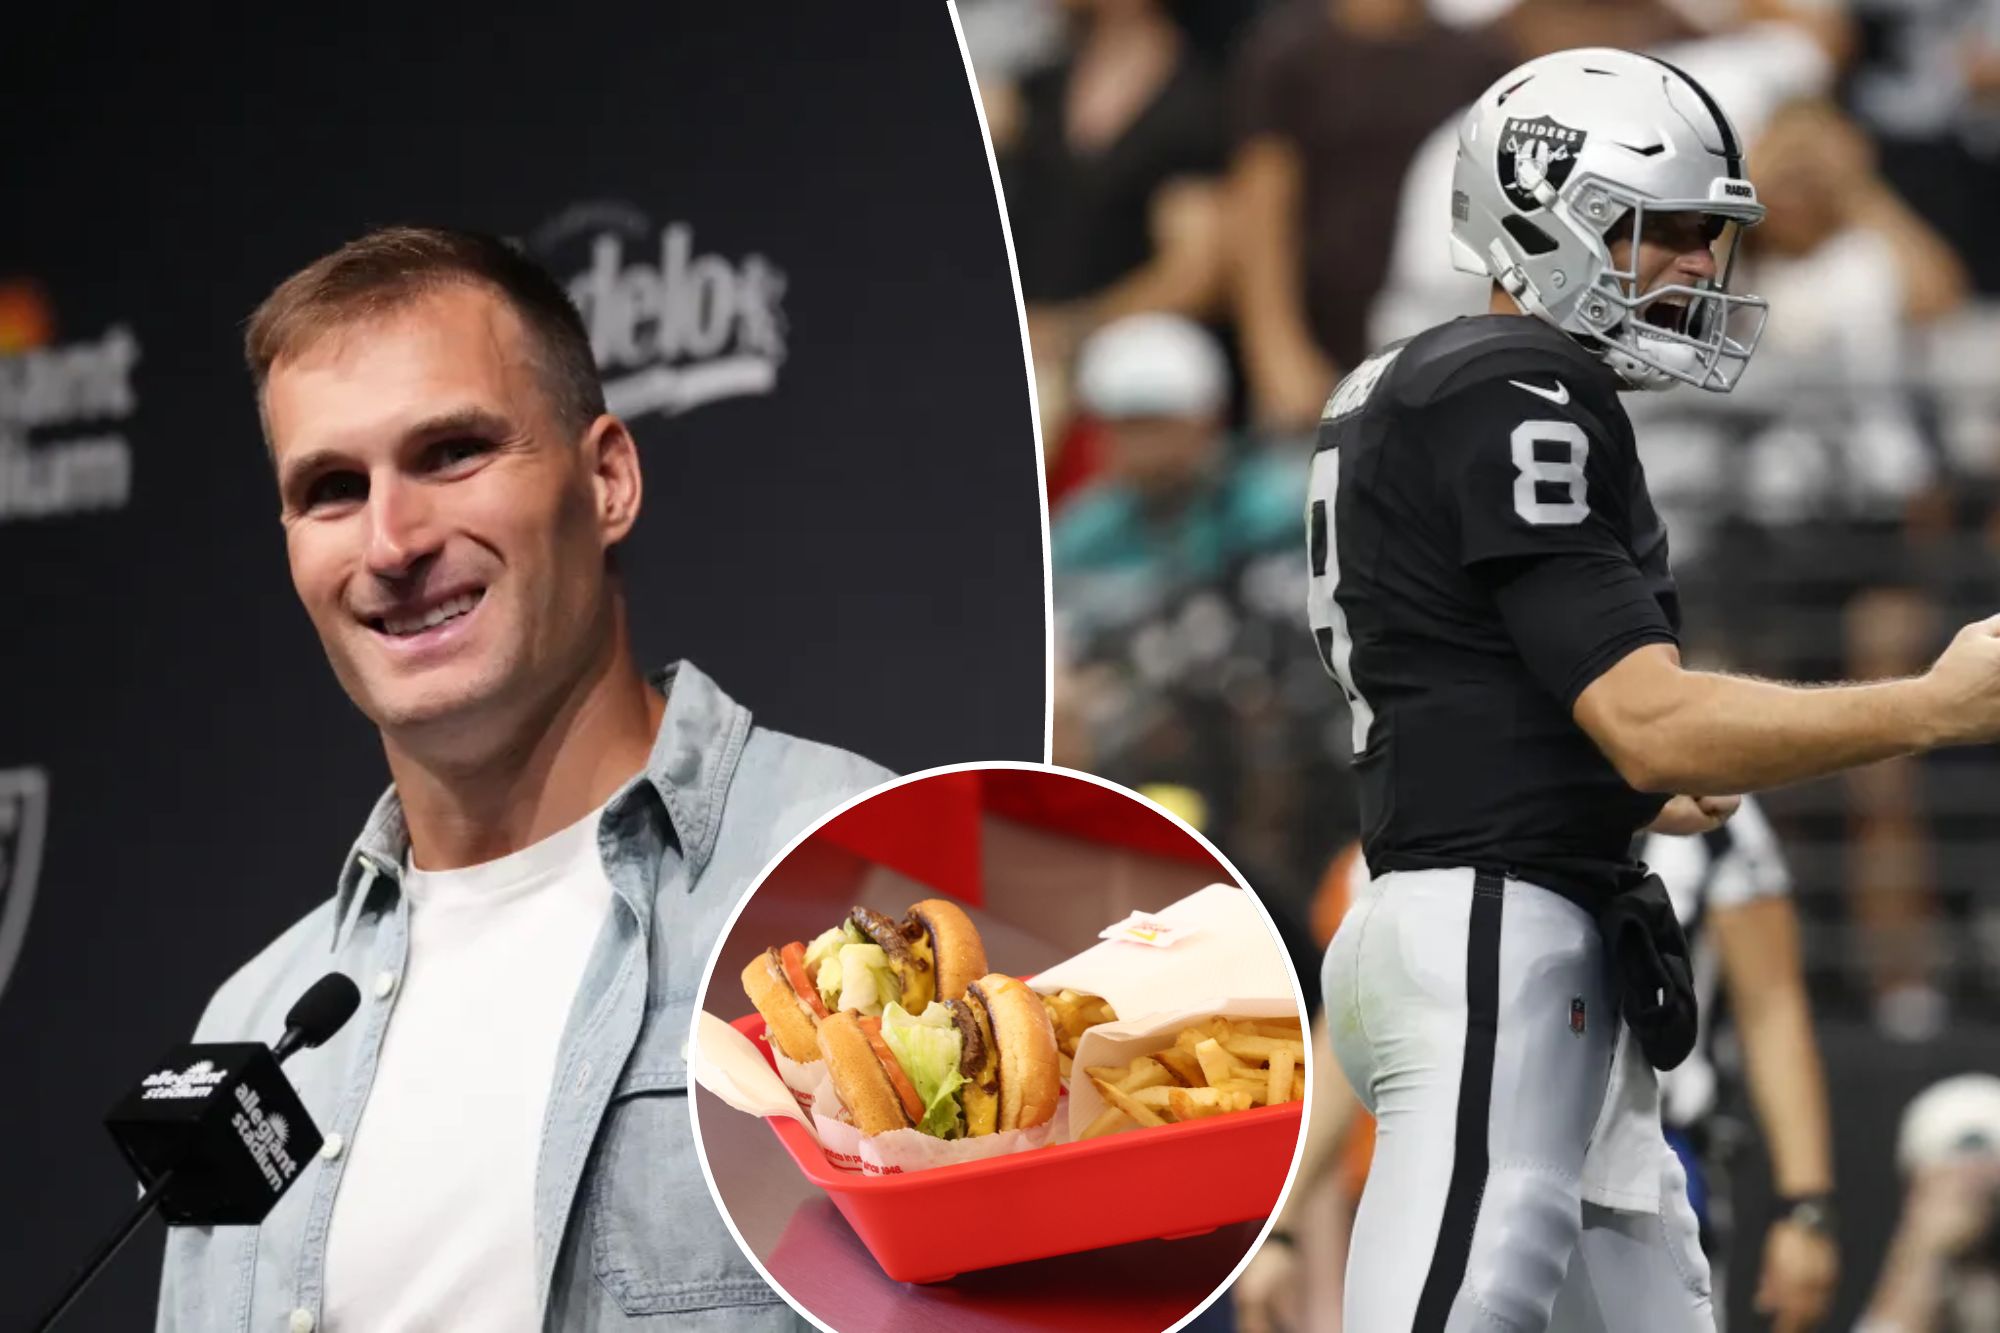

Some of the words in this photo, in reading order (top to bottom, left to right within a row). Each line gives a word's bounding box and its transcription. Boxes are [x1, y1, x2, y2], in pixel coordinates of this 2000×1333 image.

[1510, 120, 1578, 142] RAIDERS
[1510, 419, 1591, 525] 8
[141, 1068, 228, 1089] allegiant
[141, 1084, 214, 1099] stadium
[231, 1112, 284, 1192] stadium
[234, 1082, 298, 1179] allegiant
